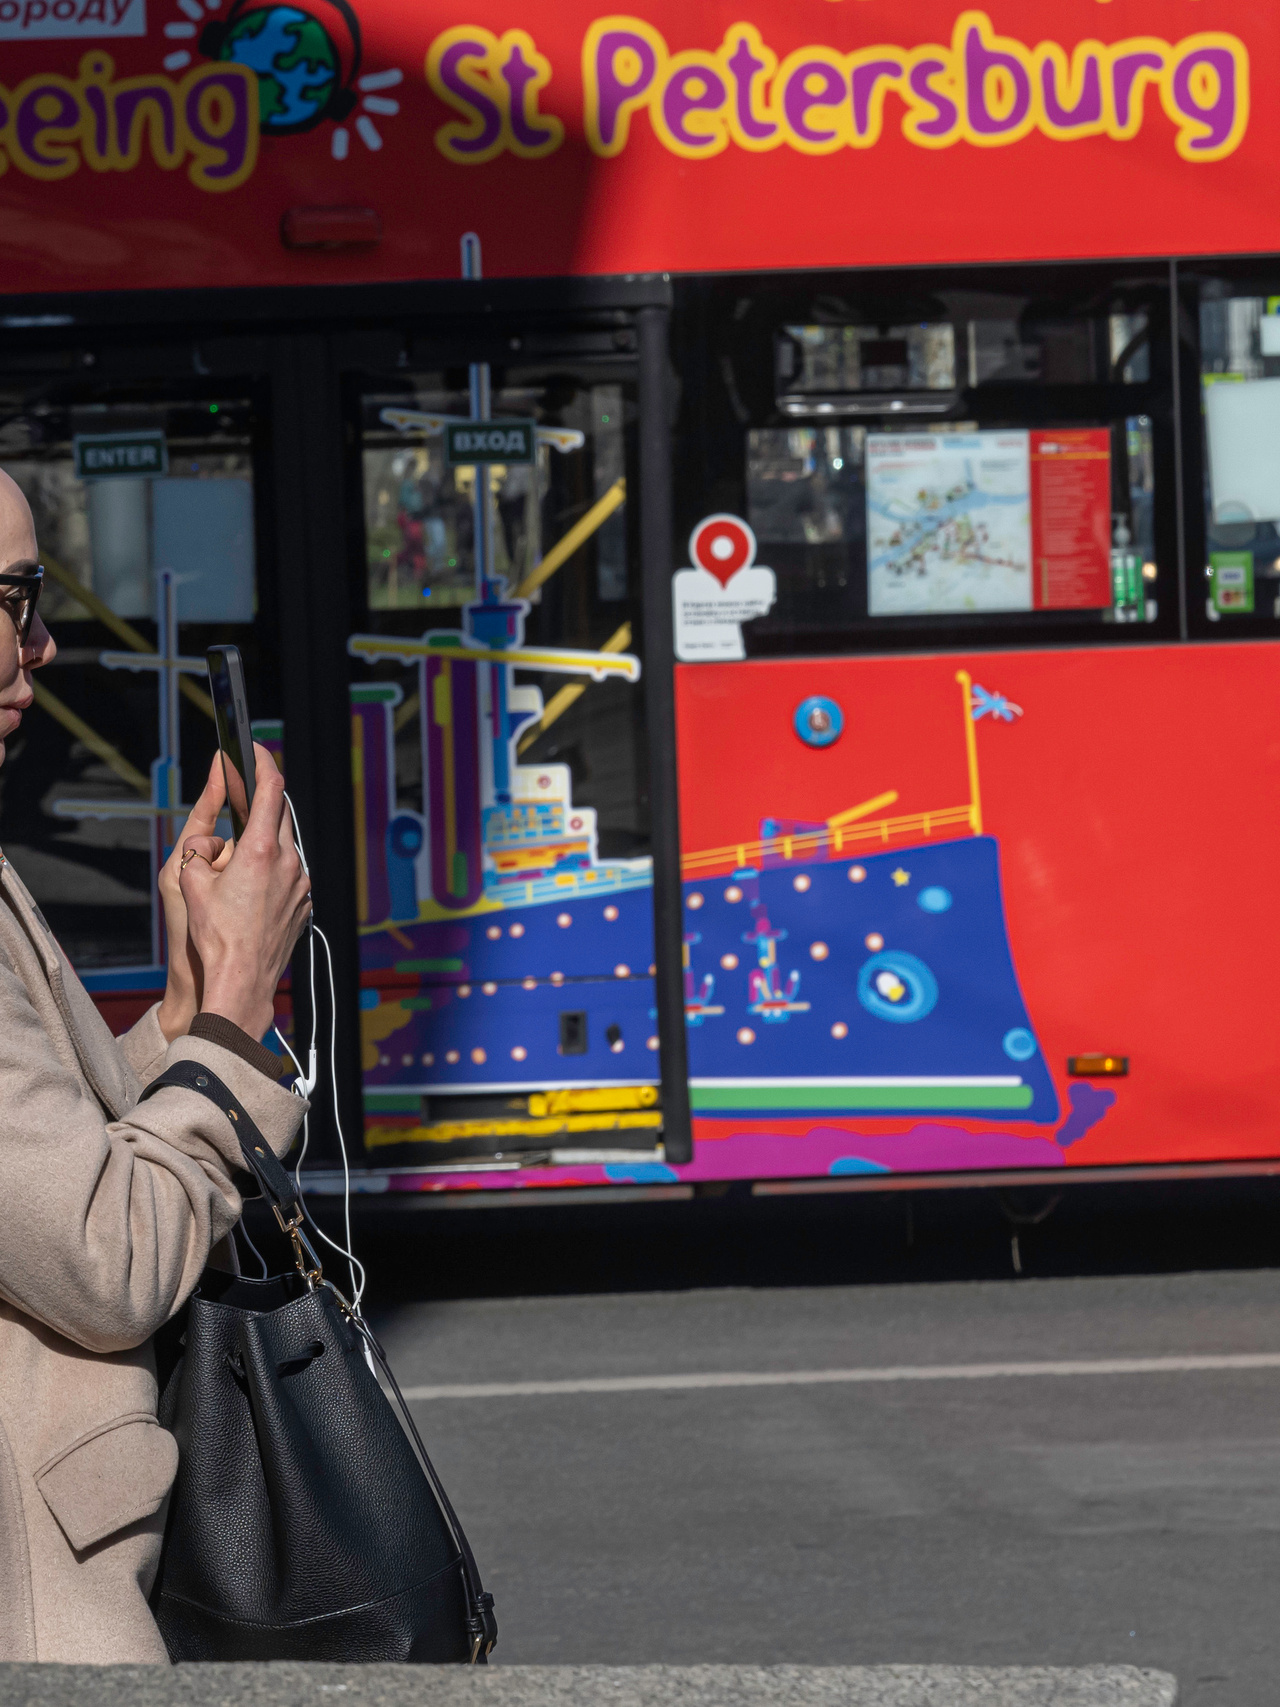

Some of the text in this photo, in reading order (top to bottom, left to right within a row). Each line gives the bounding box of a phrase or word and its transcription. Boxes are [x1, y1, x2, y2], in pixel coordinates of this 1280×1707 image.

[425, 23, 564, 164] St
[582, 10, 1250, 162] Petersburg
[453, 430, 526, 454] ВХОД
[85, 444, 157, 468] ENTER
